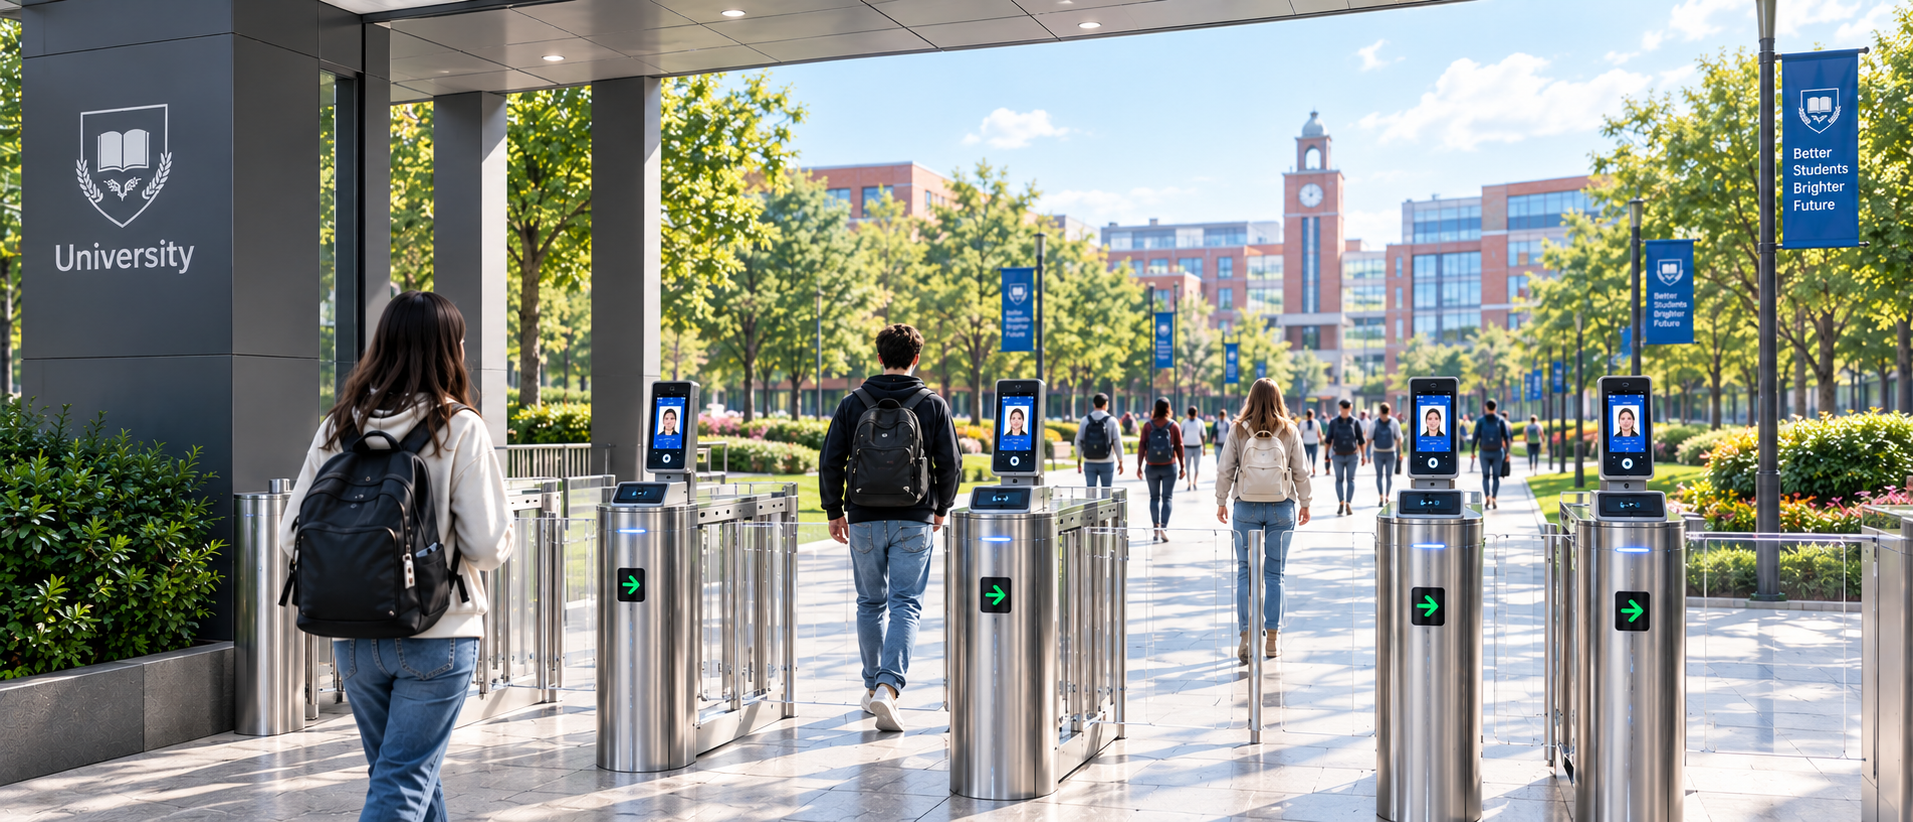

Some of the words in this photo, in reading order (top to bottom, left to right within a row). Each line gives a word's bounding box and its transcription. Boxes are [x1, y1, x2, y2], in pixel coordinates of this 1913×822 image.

[1794, 148, 1832, 160] Better
[1793, 163, 1848, 176] Students
[1794, 181, 1845, 196] Brighter
[1794, 200, 1836, 212] Future
[55, 239, 195, 274] University
